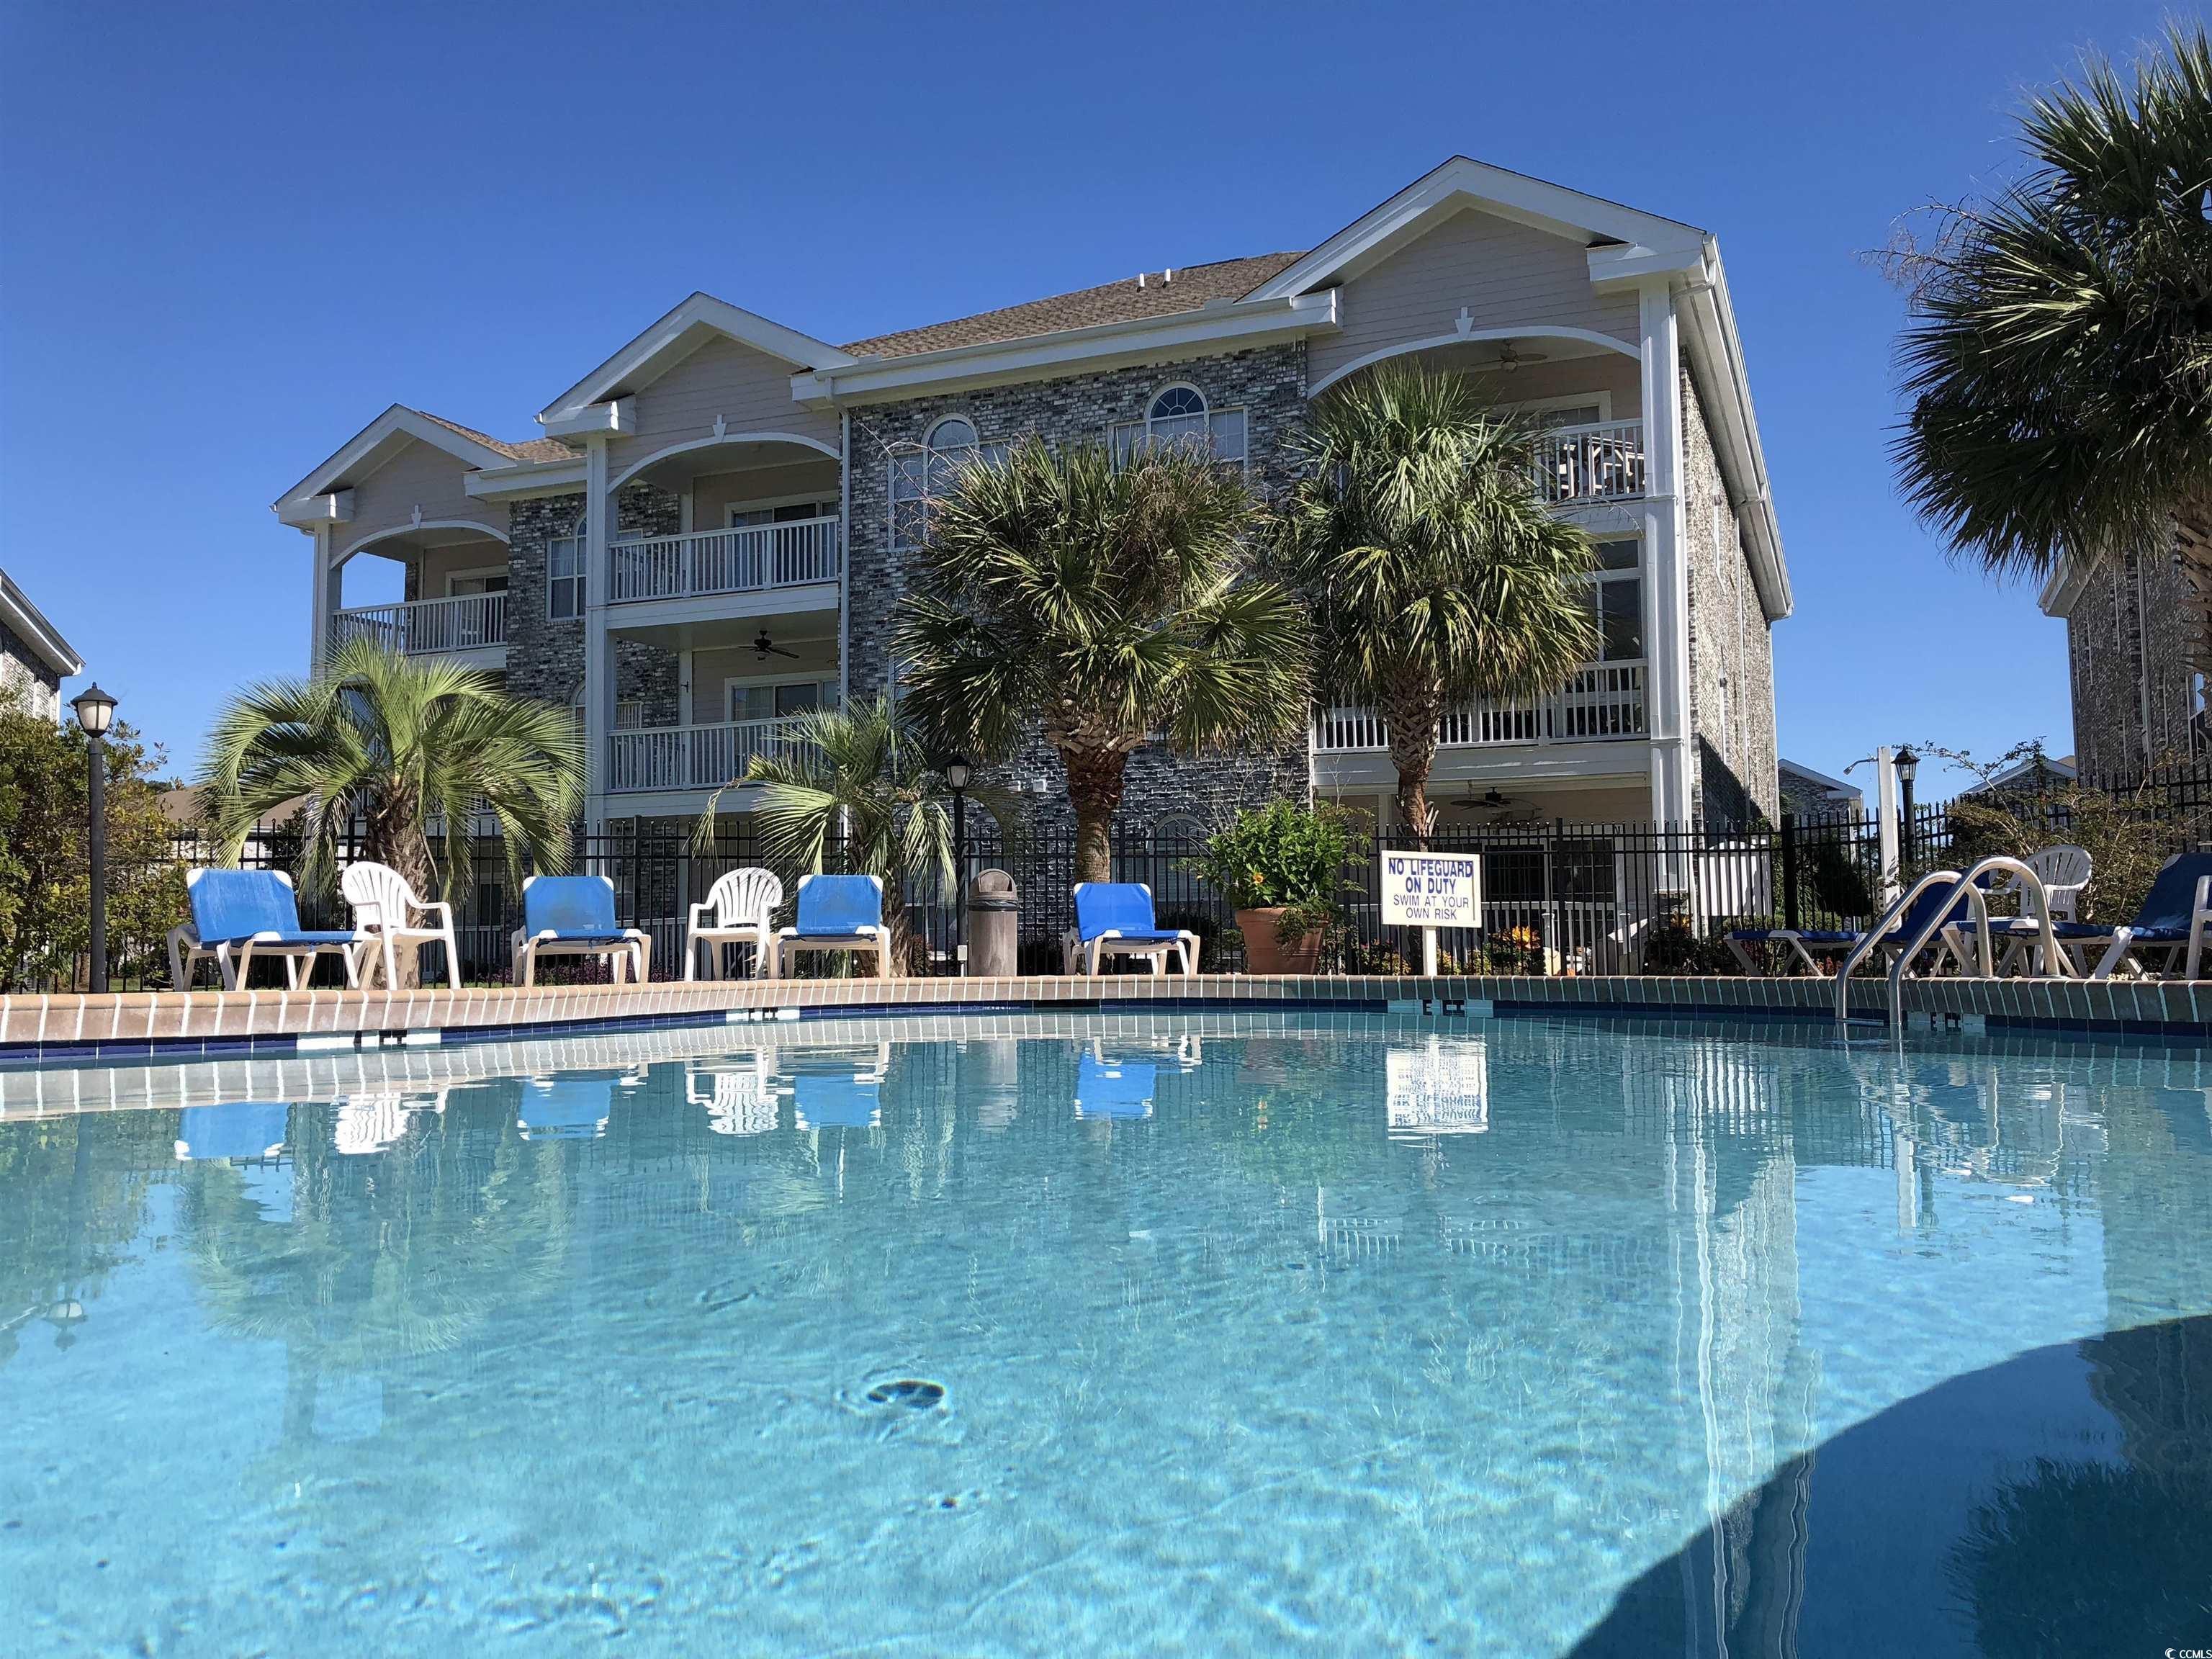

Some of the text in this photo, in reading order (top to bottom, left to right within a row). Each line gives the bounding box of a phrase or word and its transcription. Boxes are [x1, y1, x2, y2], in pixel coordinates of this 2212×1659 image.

[1388, 858, 1473, 878] NO LIFEGUARD
[1406, 876, 1456, 894] ON DUTY
[1393, 894, 1469, 908] SWIM AT YOUR
[1406, 907, 1457, 920] OWN RISK
